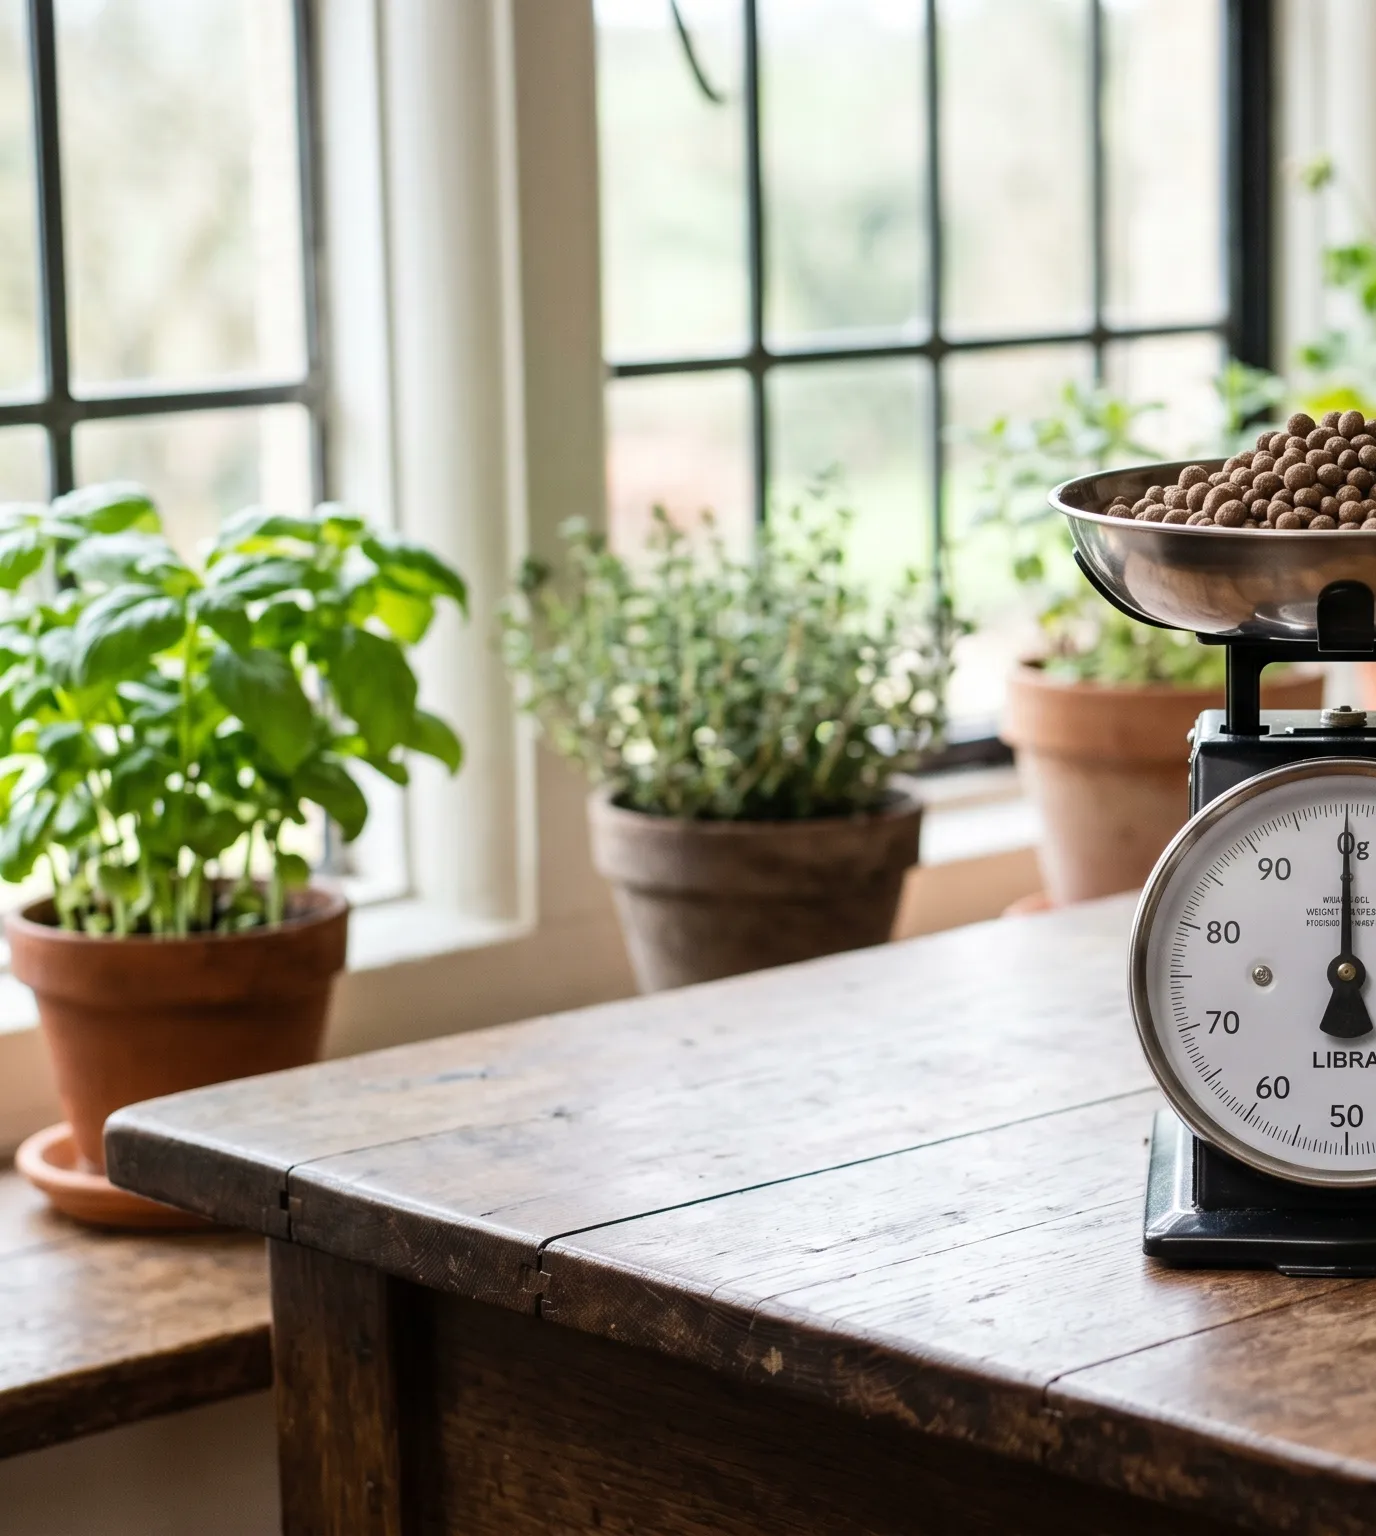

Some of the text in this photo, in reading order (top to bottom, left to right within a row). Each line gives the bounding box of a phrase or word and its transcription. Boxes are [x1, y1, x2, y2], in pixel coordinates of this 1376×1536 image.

[1257, 857, 1292, 881] 90
[1206, 920, 1241, 944] 80
[1205, 1010, 1240, 1034] 70
[1255, 1075, 1290, 1100] 60
[1330, 1104, 1364, 1128] 50
